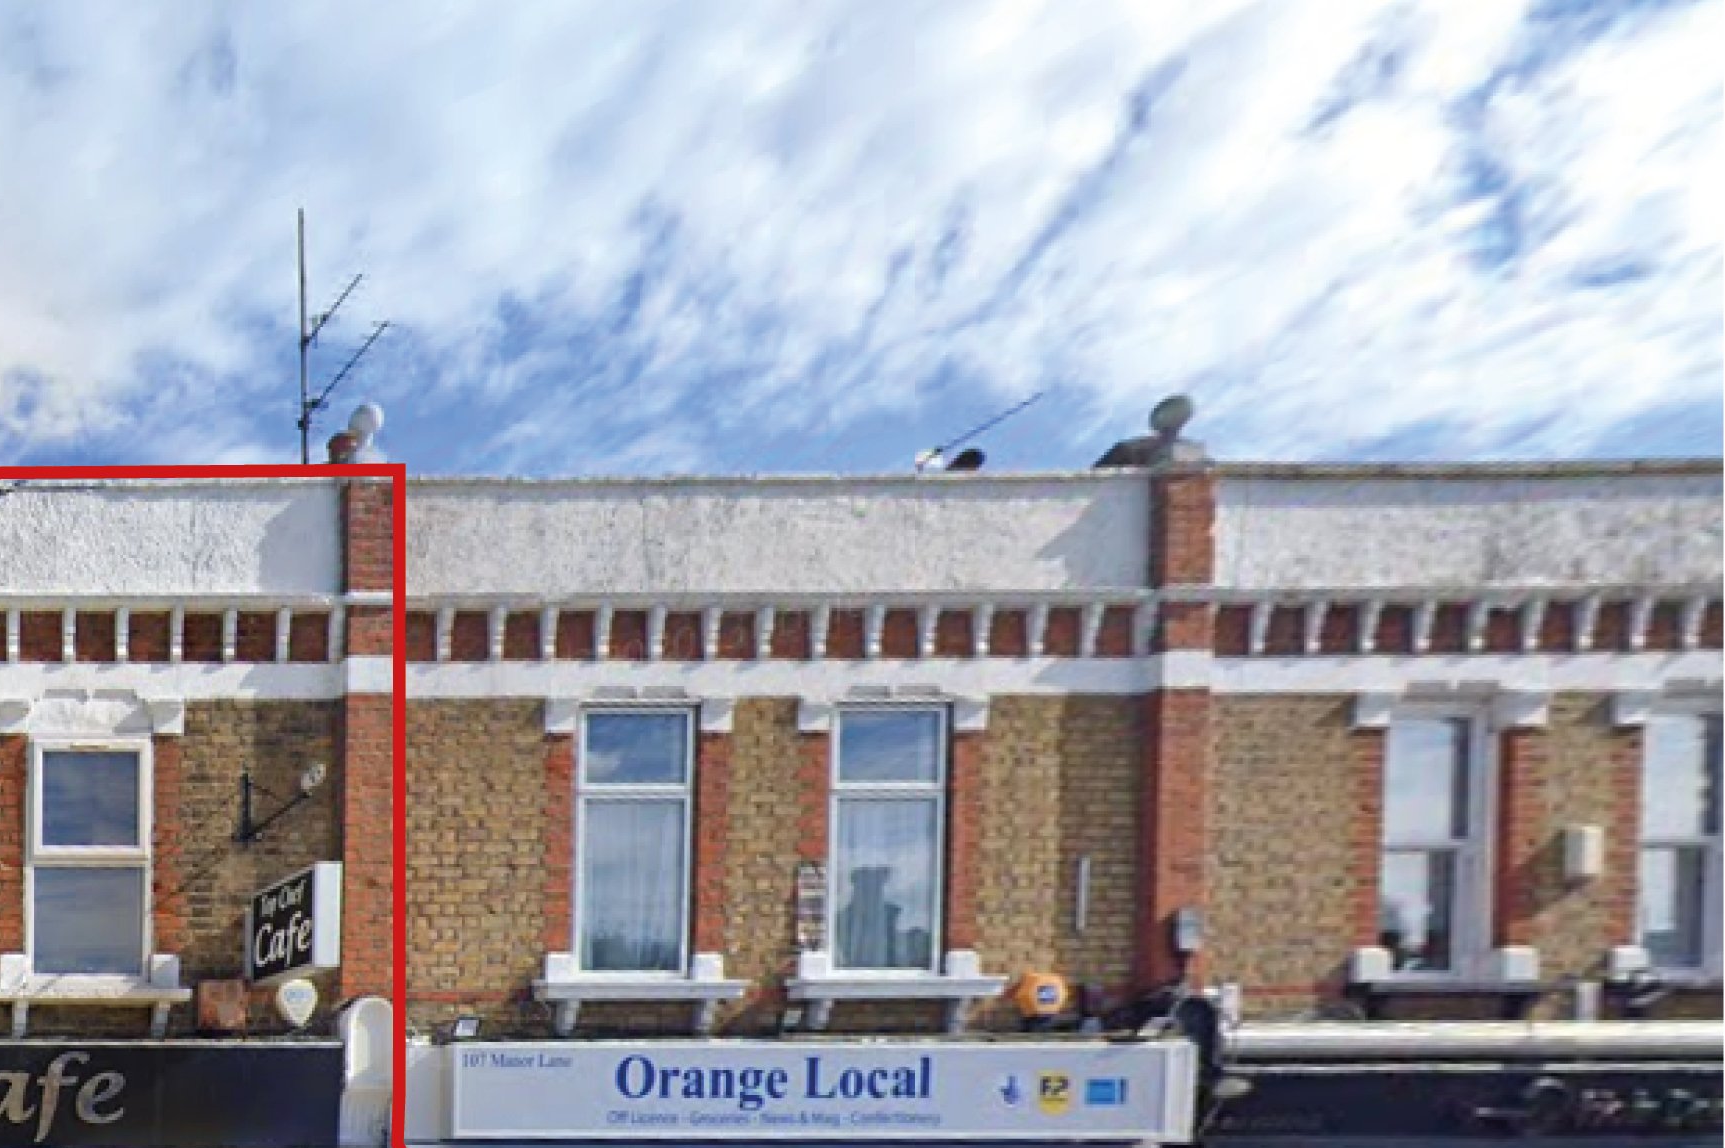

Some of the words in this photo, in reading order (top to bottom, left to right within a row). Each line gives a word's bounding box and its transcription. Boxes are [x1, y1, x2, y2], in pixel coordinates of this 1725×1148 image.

[254, 910, 313, 969] Cafe
[491, 1053, 536, 1068] Manor
[539, 1053, 573, 1068] Lane
[615, 1053, 788, 1112] Orange
[804, 1053, 933, 1100] Local
